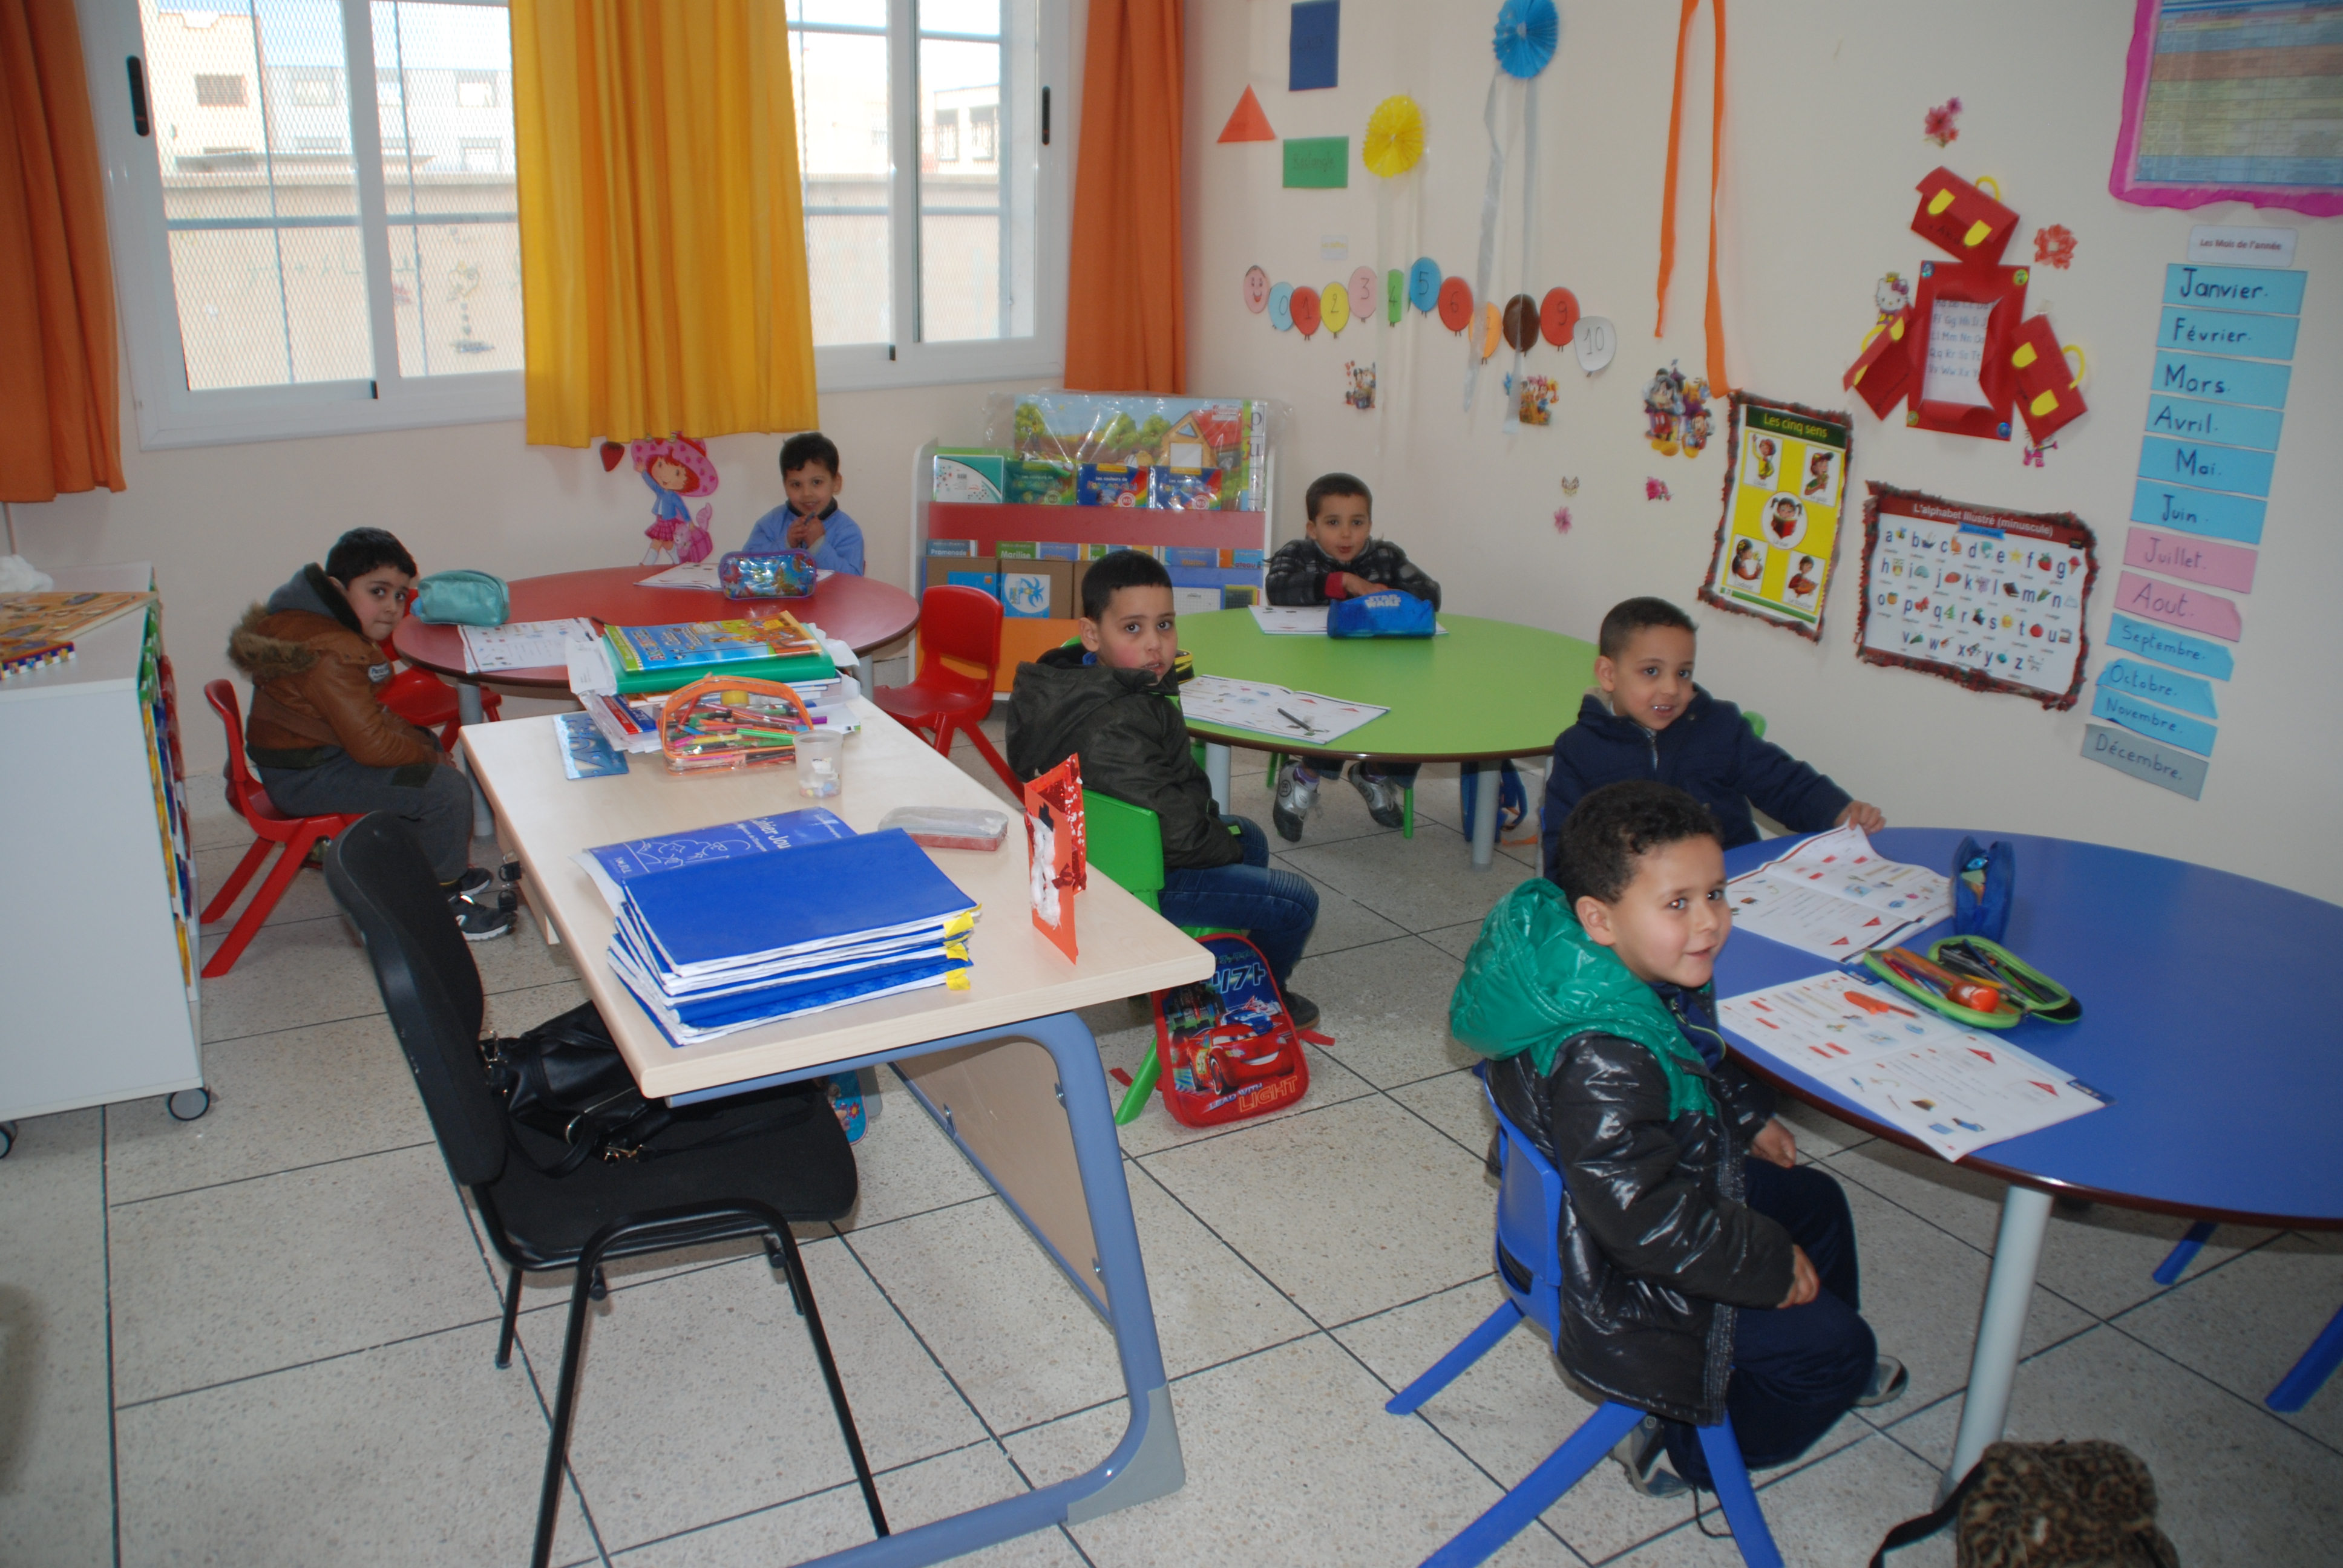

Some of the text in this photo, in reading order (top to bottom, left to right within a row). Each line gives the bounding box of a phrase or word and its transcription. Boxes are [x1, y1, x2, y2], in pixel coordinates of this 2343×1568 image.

[2200, 238, 2213, 247] Les
[2215, 239, 2235, 248] Mois
[2236, 240, 2247, 249] de
[1302, 296, 1312, 320] 1
[1331, 293, 1340, 313] 2
[1361, 277, 1371, 299] 3
[1388, 286, 1398, 307] 4
[1419, 271, 1429, 295] 5
[1450, 291, 1460, 313] 6
[1558, 301, 1568, 326] 9
[1584, 327, 1604, 355] 10
[1251, 411, 1262, 431] p
[1764, 413, 1827, 437] Les cinq sens
[1250, 444, 1260, 457] u
[1913, 503, 1961, 520] L'alphabet
[1997, 518, 2054, 537] (minuscule)
[1886, 531, 2066, 579] a b c d e f g
[1367, 593, 1401, 603] STAR
[1881, 557, 2062, 609] h i j k l m n
[1364, 598, 1401, 609] WARS
[1878, 593, 1886, 606] o
[1903, 599, 1913, 615] p
[1934, 606, 1942, 622] q
[1961, 610, 1968, 623] r
[1989, 617, 1997, 630] s
[2019, 620, 2025, 636] t
[2048, 630, 2057, 643] u
[1902, 631, 1910, 643] v
[1930, 637, 1940, 650] w
[1958, 643, 1967, 657] x
[1984, 650, 1994, 667] y
[2014, 656, 2024, 670] z
[750, 817, 779, 835] ahier
[768, 835, 791, 849] Jou
[1209, 1082, 1263, 1111] LEAD WITH
[1239, 1075, 1298, 1113] LIGHT
